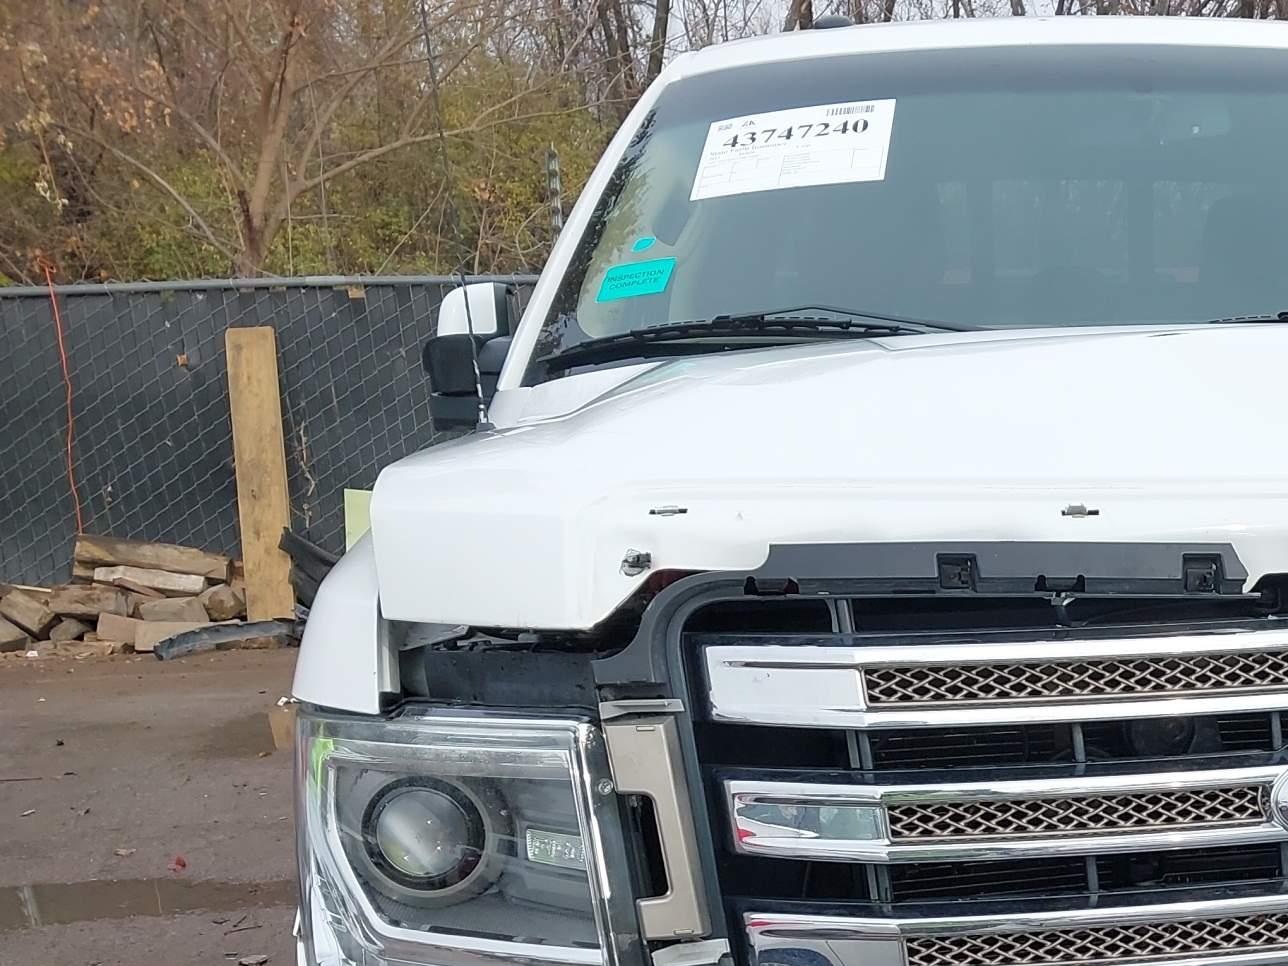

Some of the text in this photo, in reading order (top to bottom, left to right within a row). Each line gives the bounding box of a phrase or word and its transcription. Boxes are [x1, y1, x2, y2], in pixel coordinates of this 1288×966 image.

[722, 118, 869, 149] 43747240
[607, 269, 665, 283] INSPECTION
[608, 277, 660, 290] COMPLETE
